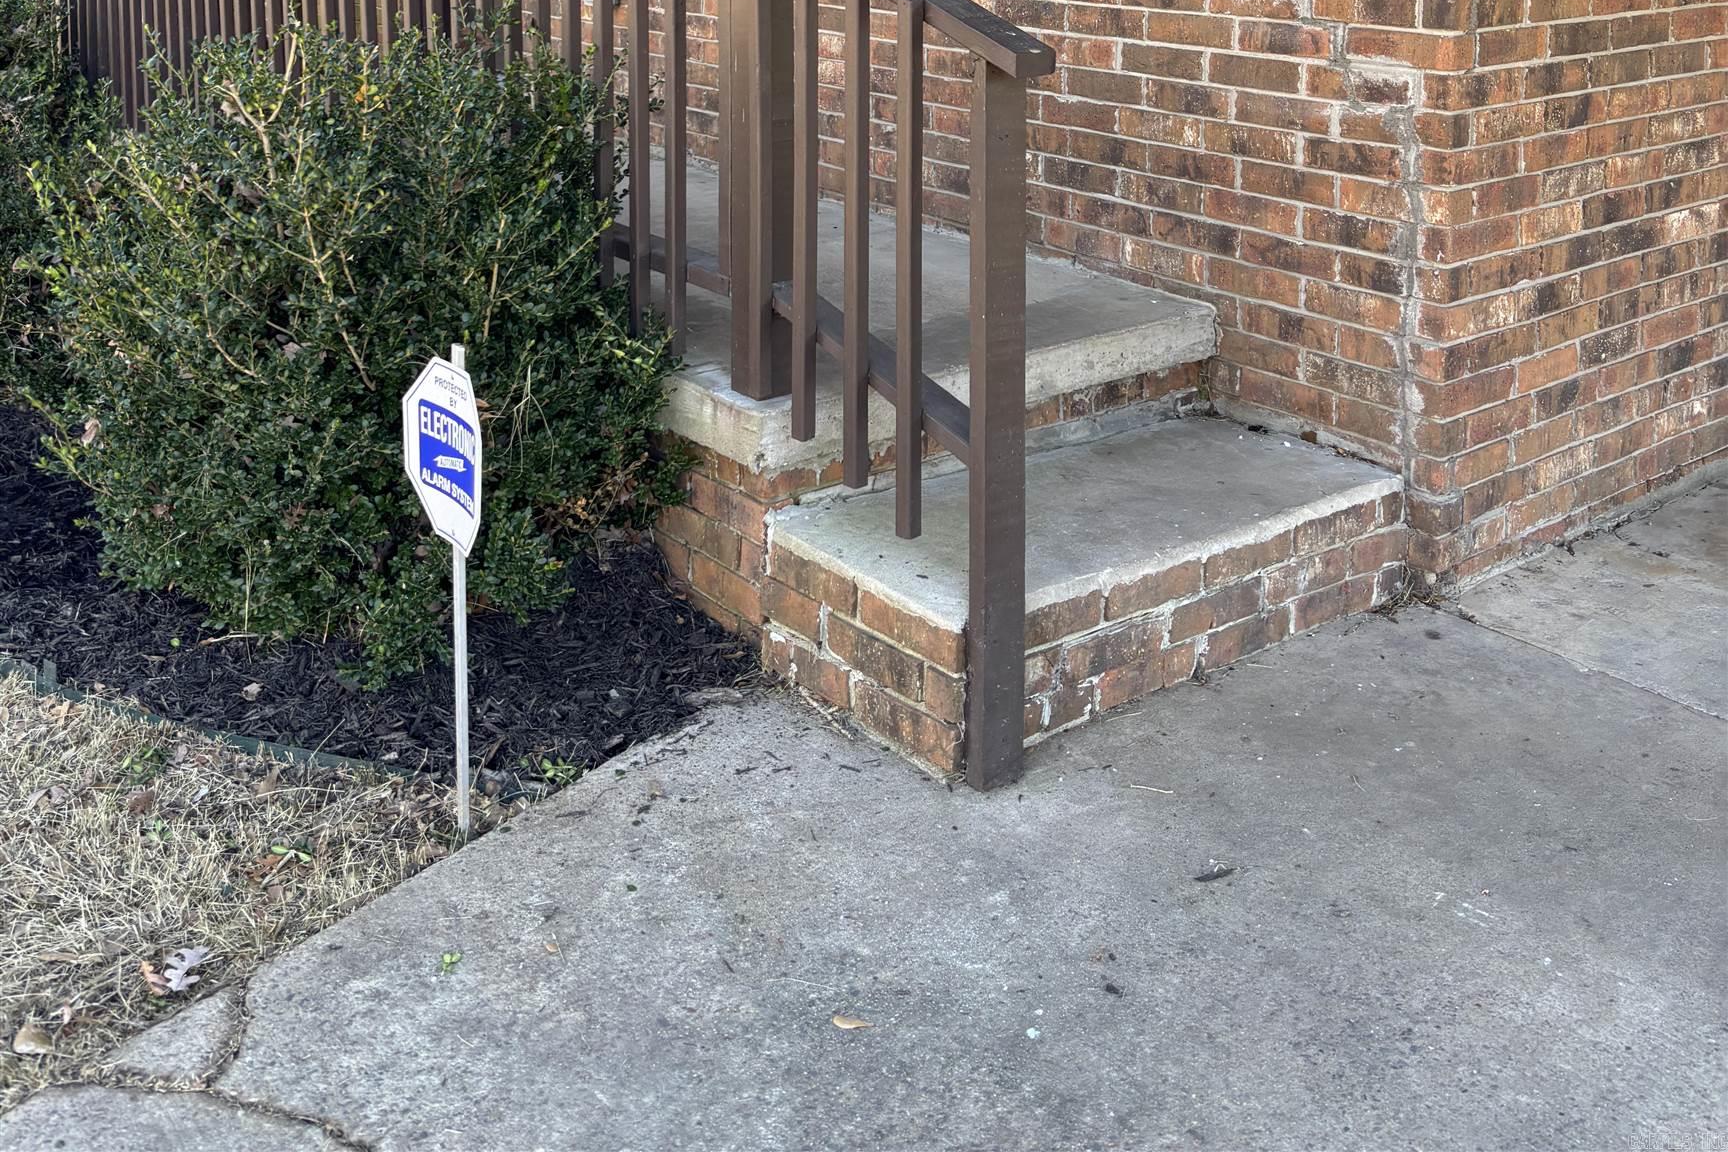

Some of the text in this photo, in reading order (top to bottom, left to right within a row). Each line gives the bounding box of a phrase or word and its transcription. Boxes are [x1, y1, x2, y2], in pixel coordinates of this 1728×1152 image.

[435, 376, 467, 401] PROTECTED
[449, 397, 458, 409] BY
[420, 405, 475, 465] ELECTRONIC
[421, 467, 451, 494] ALARM
